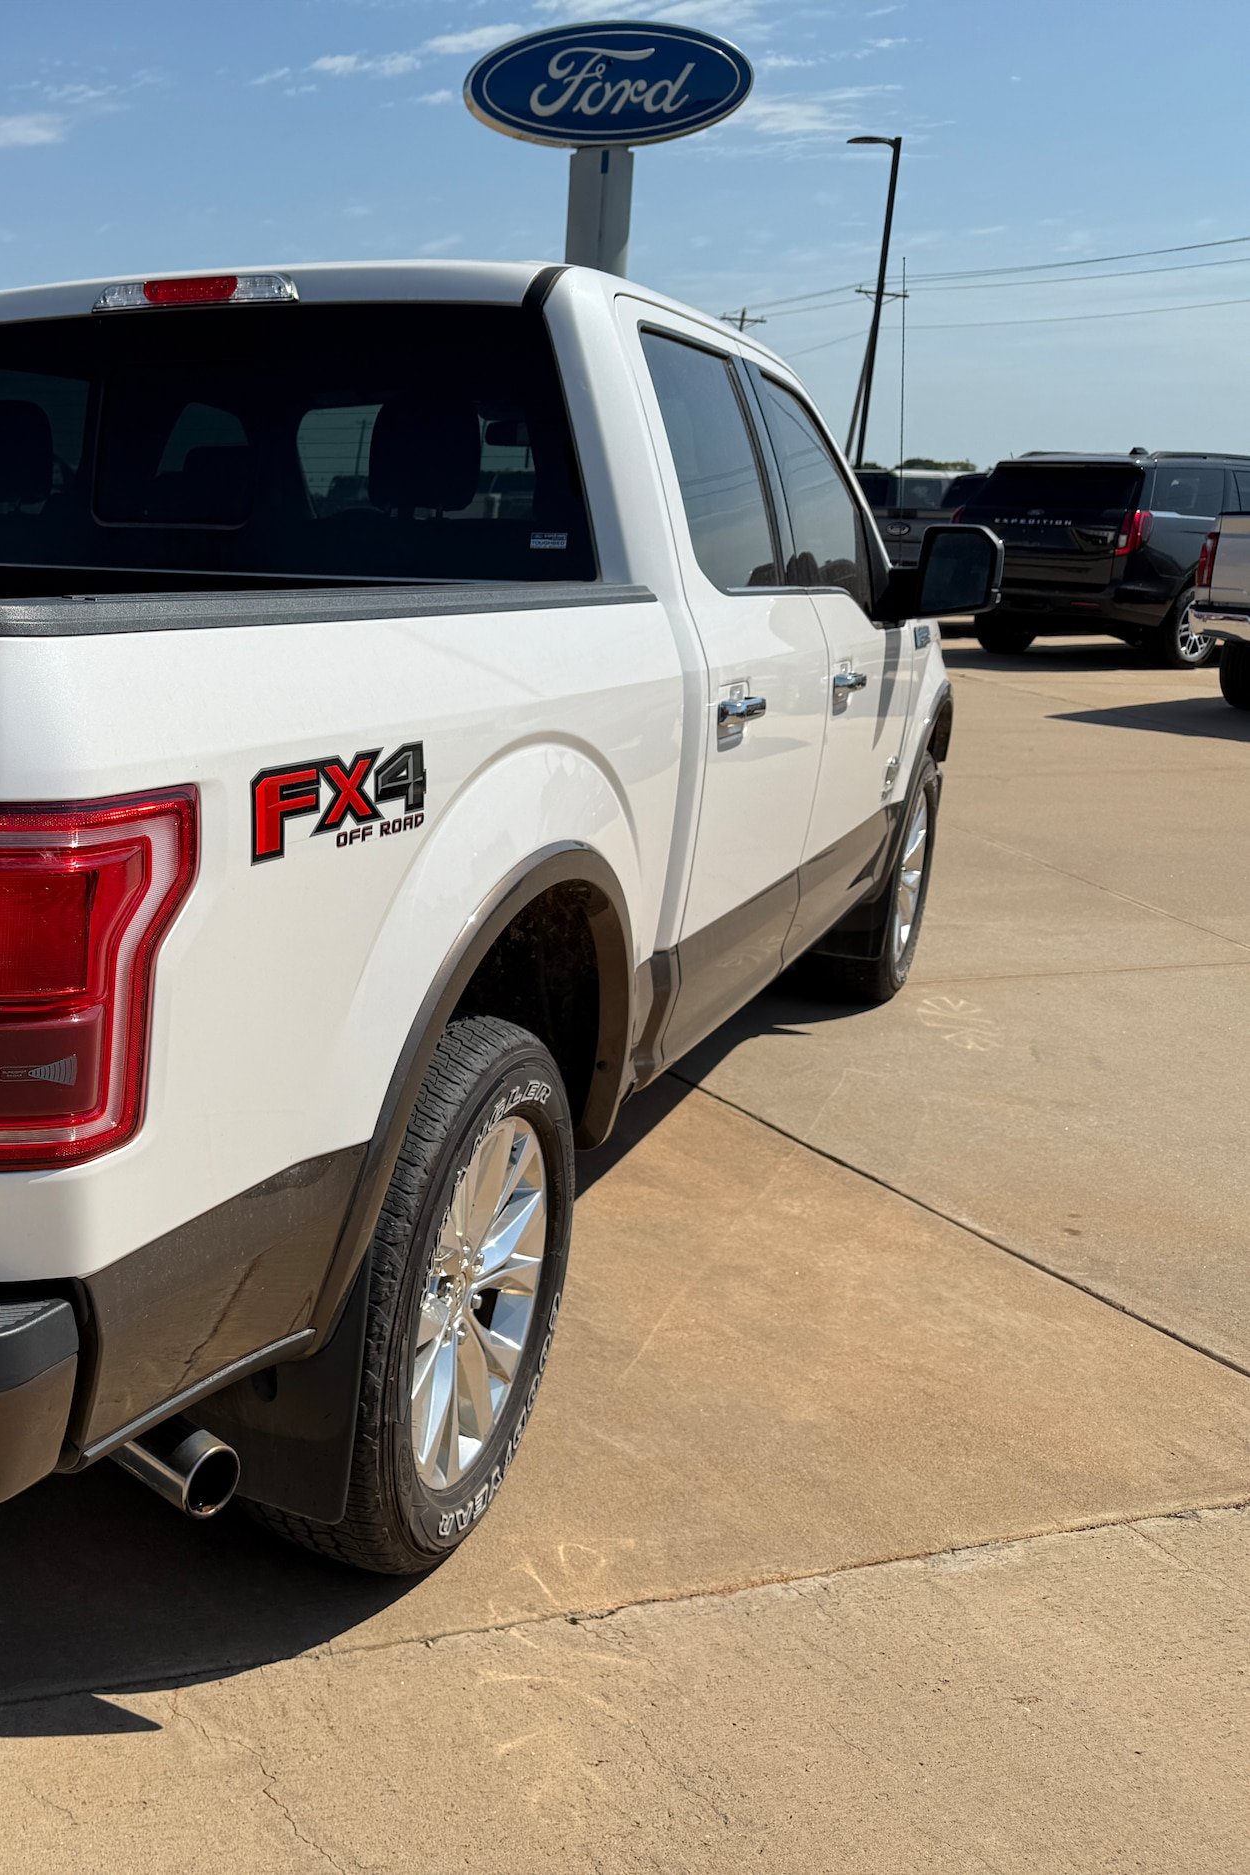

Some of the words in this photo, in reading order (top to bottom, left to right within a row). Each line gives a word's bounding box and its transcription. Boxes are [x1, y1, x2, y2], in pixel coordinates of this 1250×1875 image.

[529, 46, 696, 117] Ford
[250, 739, 427, 867] FX4
[336, 825, 373, 848] OFF
[379, 812, 425, 838] ROAD
